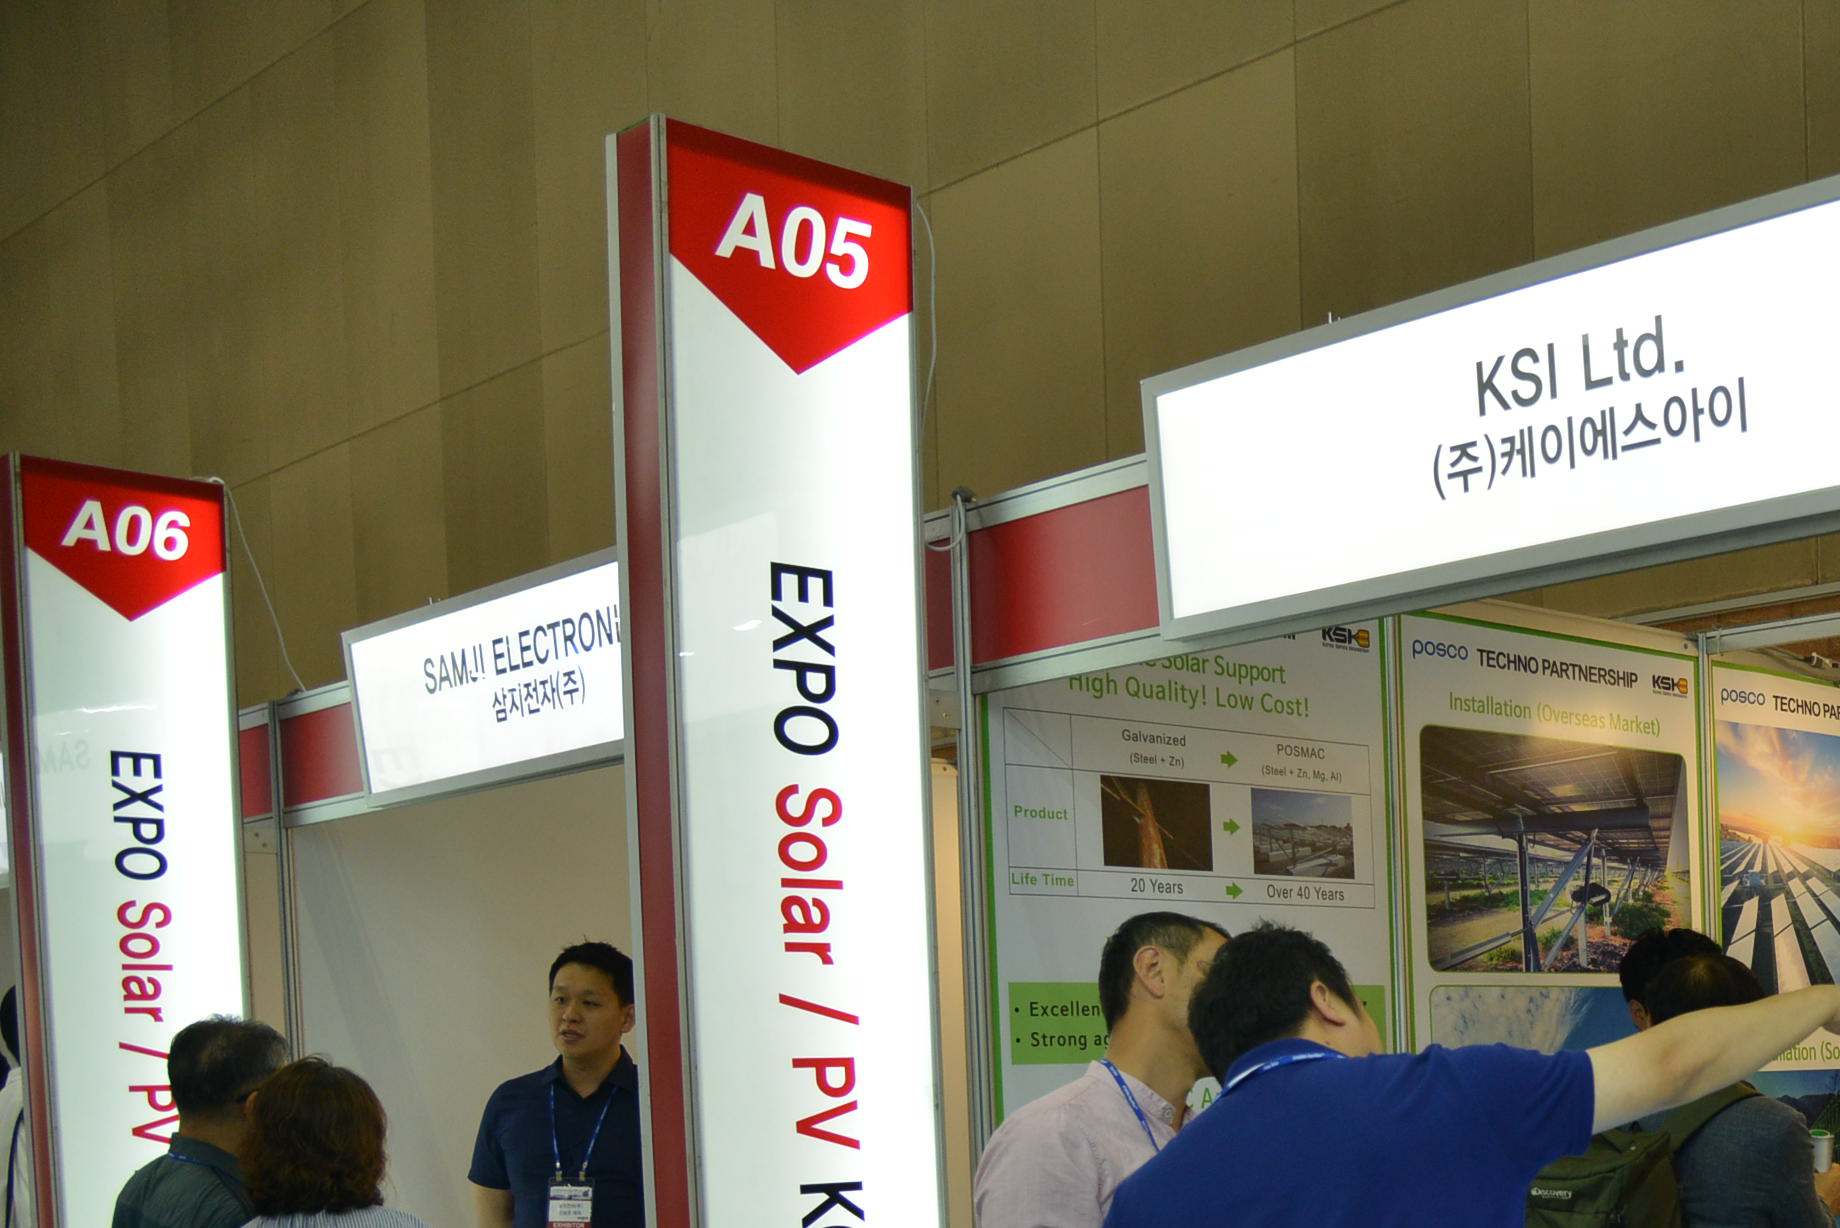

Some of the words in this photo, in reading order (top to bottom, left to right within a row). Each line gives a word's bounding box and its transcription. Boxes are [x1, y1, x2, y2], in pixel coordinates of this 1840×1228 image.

[715, 191, 872, 290] A05
[1476, 342, 1557, 417] KSI
[1582, 314, 1684, 392] Ltd.
[1433, 376, 1747, 501] (주)케이에스아이
[61, 499, 191, 561] A06
[770, 561, 839, 756] EXPO
[1213, 655, 1287, 685] Support
[1412, 639, 1469, 661] posco
[1477, 648, 1540, 675] TECHNO
[1542, 659, 1639, 689] PARTNERSHIP
[492, 665, 586, 723] 삼지전자(주)
[1069, 672, 1118, 700] High
[1125, 675, 1207, 710] Quality!
[1216, 686, 1254, 711] Low
[1260, 694, 1309, 717] Cost!
[1720, 688, 1766, 706] posco
[1772, 695, 1821, 717] TECHNO
[1449, 692, 1532, 720] Installation
[1536, 701, 1607, 730] (Overseas
[1608, 712, 1661, 738] Market)
[1121, 728, 1187, 747] Galvanized
[1276, 743, 1326, 760] POSMAC
[1129, 752, 1158, 767] (Steel
[1169, 755, 1185, 769] Zn)
[1261, 764, 1286, 778] (Steel
[110, 750, 168, 881] EXPO
[1013, 804, 1069, 821] Product
[775, 783, 843, 966] Solar
[1011, 870, 1041, 887] Life
[1043, 872, 1075, 888] Time
[1130, 878, 1146, 894] 20
[1149, 878, 1184, 896] Years
[1266, 884, 1294, 900] Over
[1297, 885, 1311, 901] 40
[1313, 886, 1345, 902] Years
[116, 900, 173, 1023] Solar
[778, 992, 860, 1026] /
[1029, 1001, 1101, 1018] Excellen
[1030, 1032, 1088, 1050] Strong
[791, 1056, 861, 1150] PV
